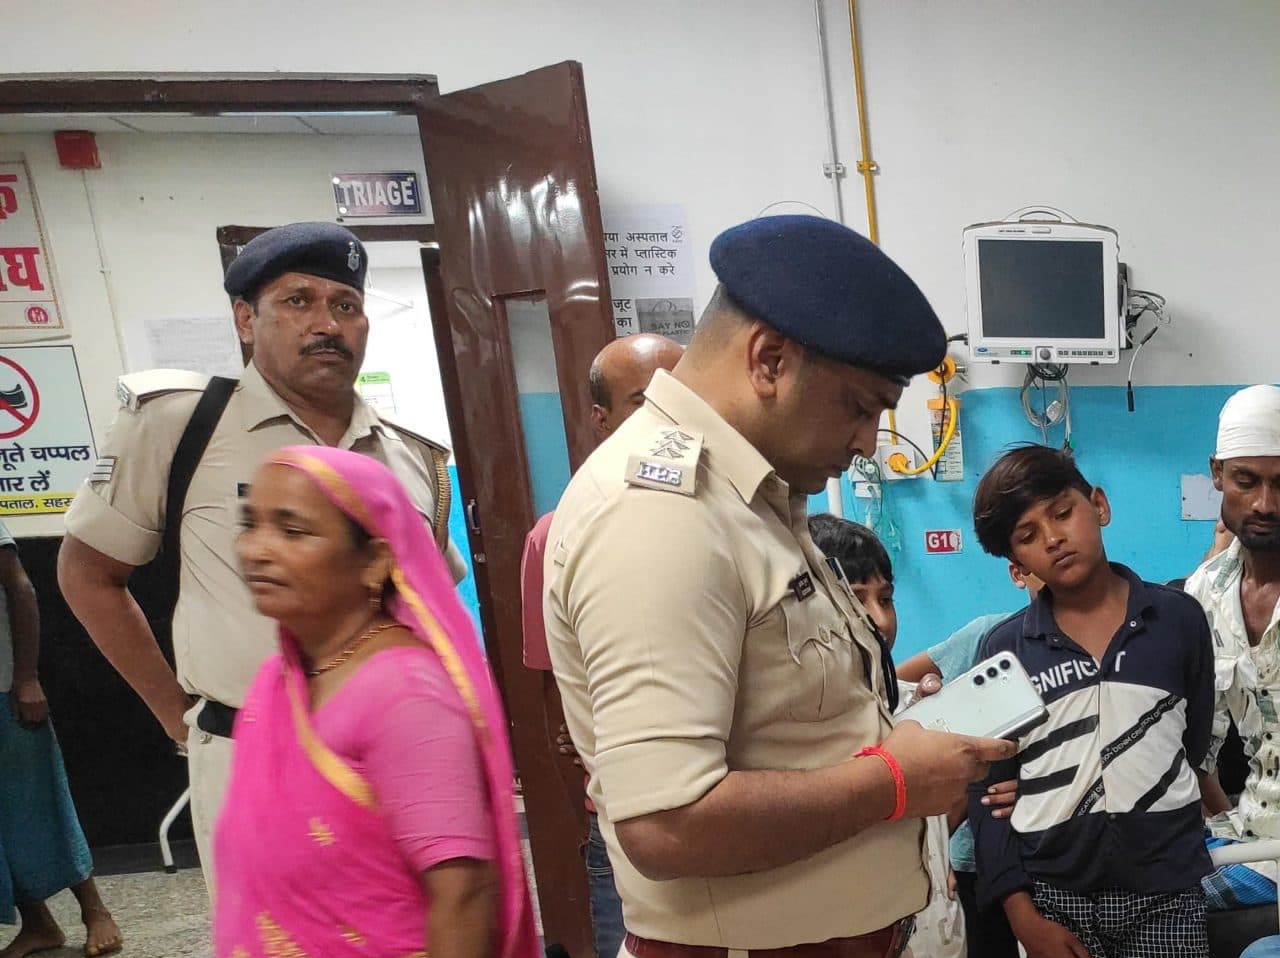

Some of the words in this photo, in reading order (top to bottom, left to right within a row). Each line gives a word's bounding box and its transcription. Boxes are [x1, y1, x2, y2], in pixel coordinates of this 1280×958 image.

[340, 180, 415, 206] TRIAGE
[626, 232, 668, 242] अस्पताल
[635, 246, 677, 259] प्लास्टिक
[29, 445, 90, 461] चप्पल
[28, 469, 51, 491] लें
